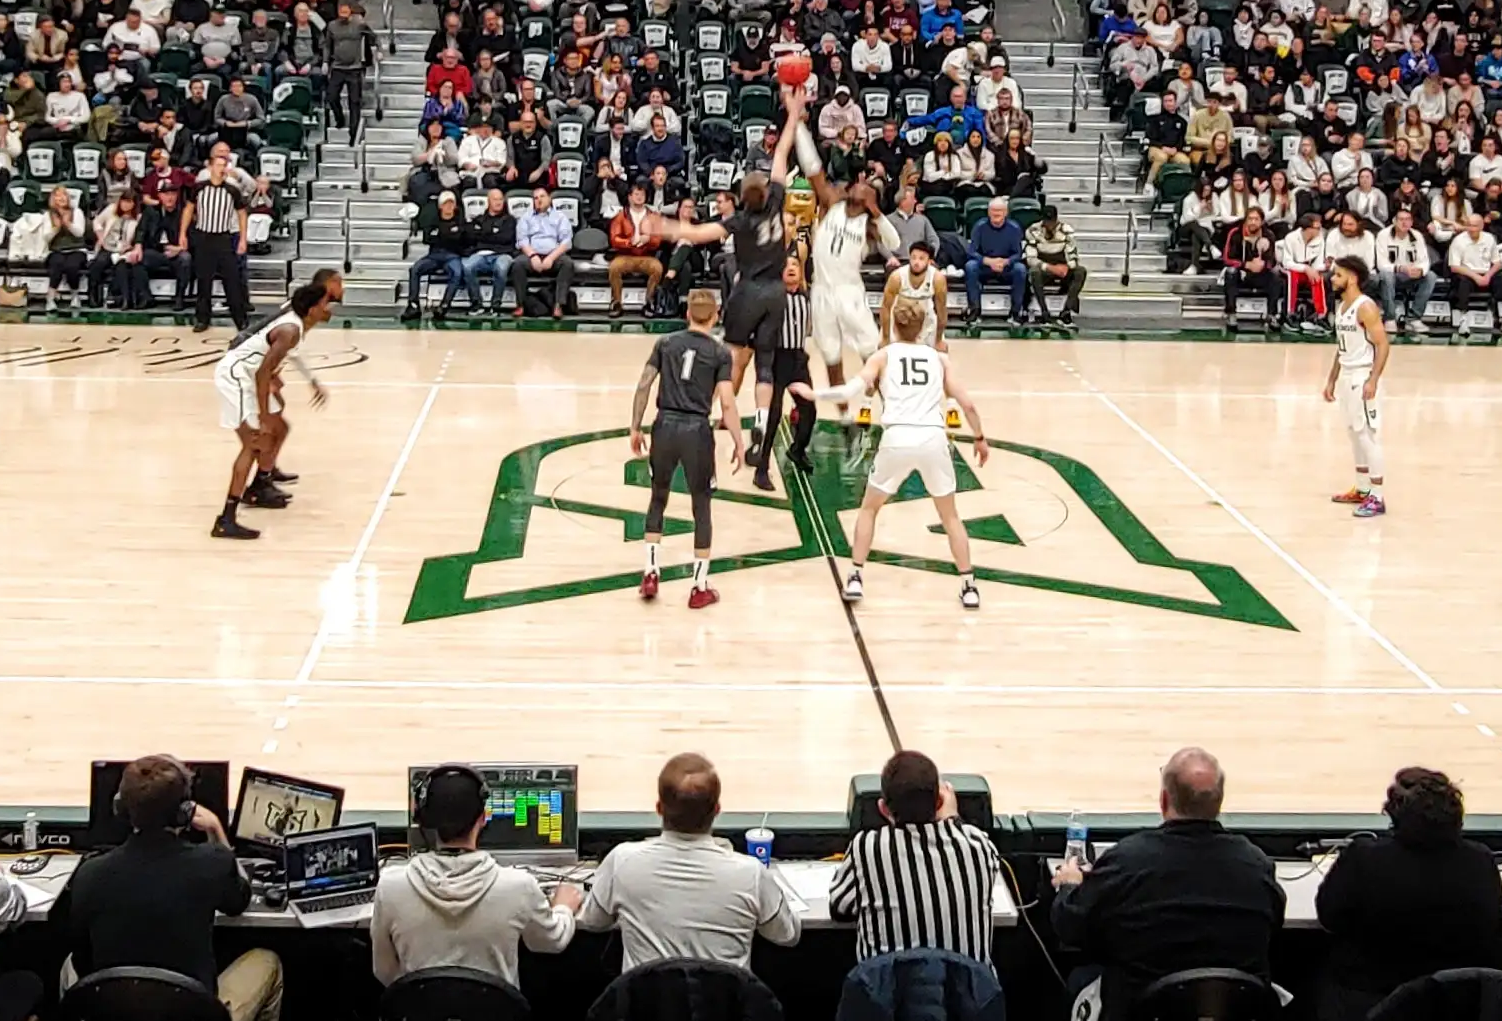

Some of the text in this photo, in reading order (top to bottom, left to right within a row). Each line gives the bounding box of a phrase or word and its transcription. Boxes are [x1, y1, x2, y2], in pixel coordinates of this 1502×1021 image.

[59, 335, 233, 346] OURT
[680, 349, 697, 381] 1
[899, 356, 930, 387] 15
[13, 834, 71, 845] nvco
